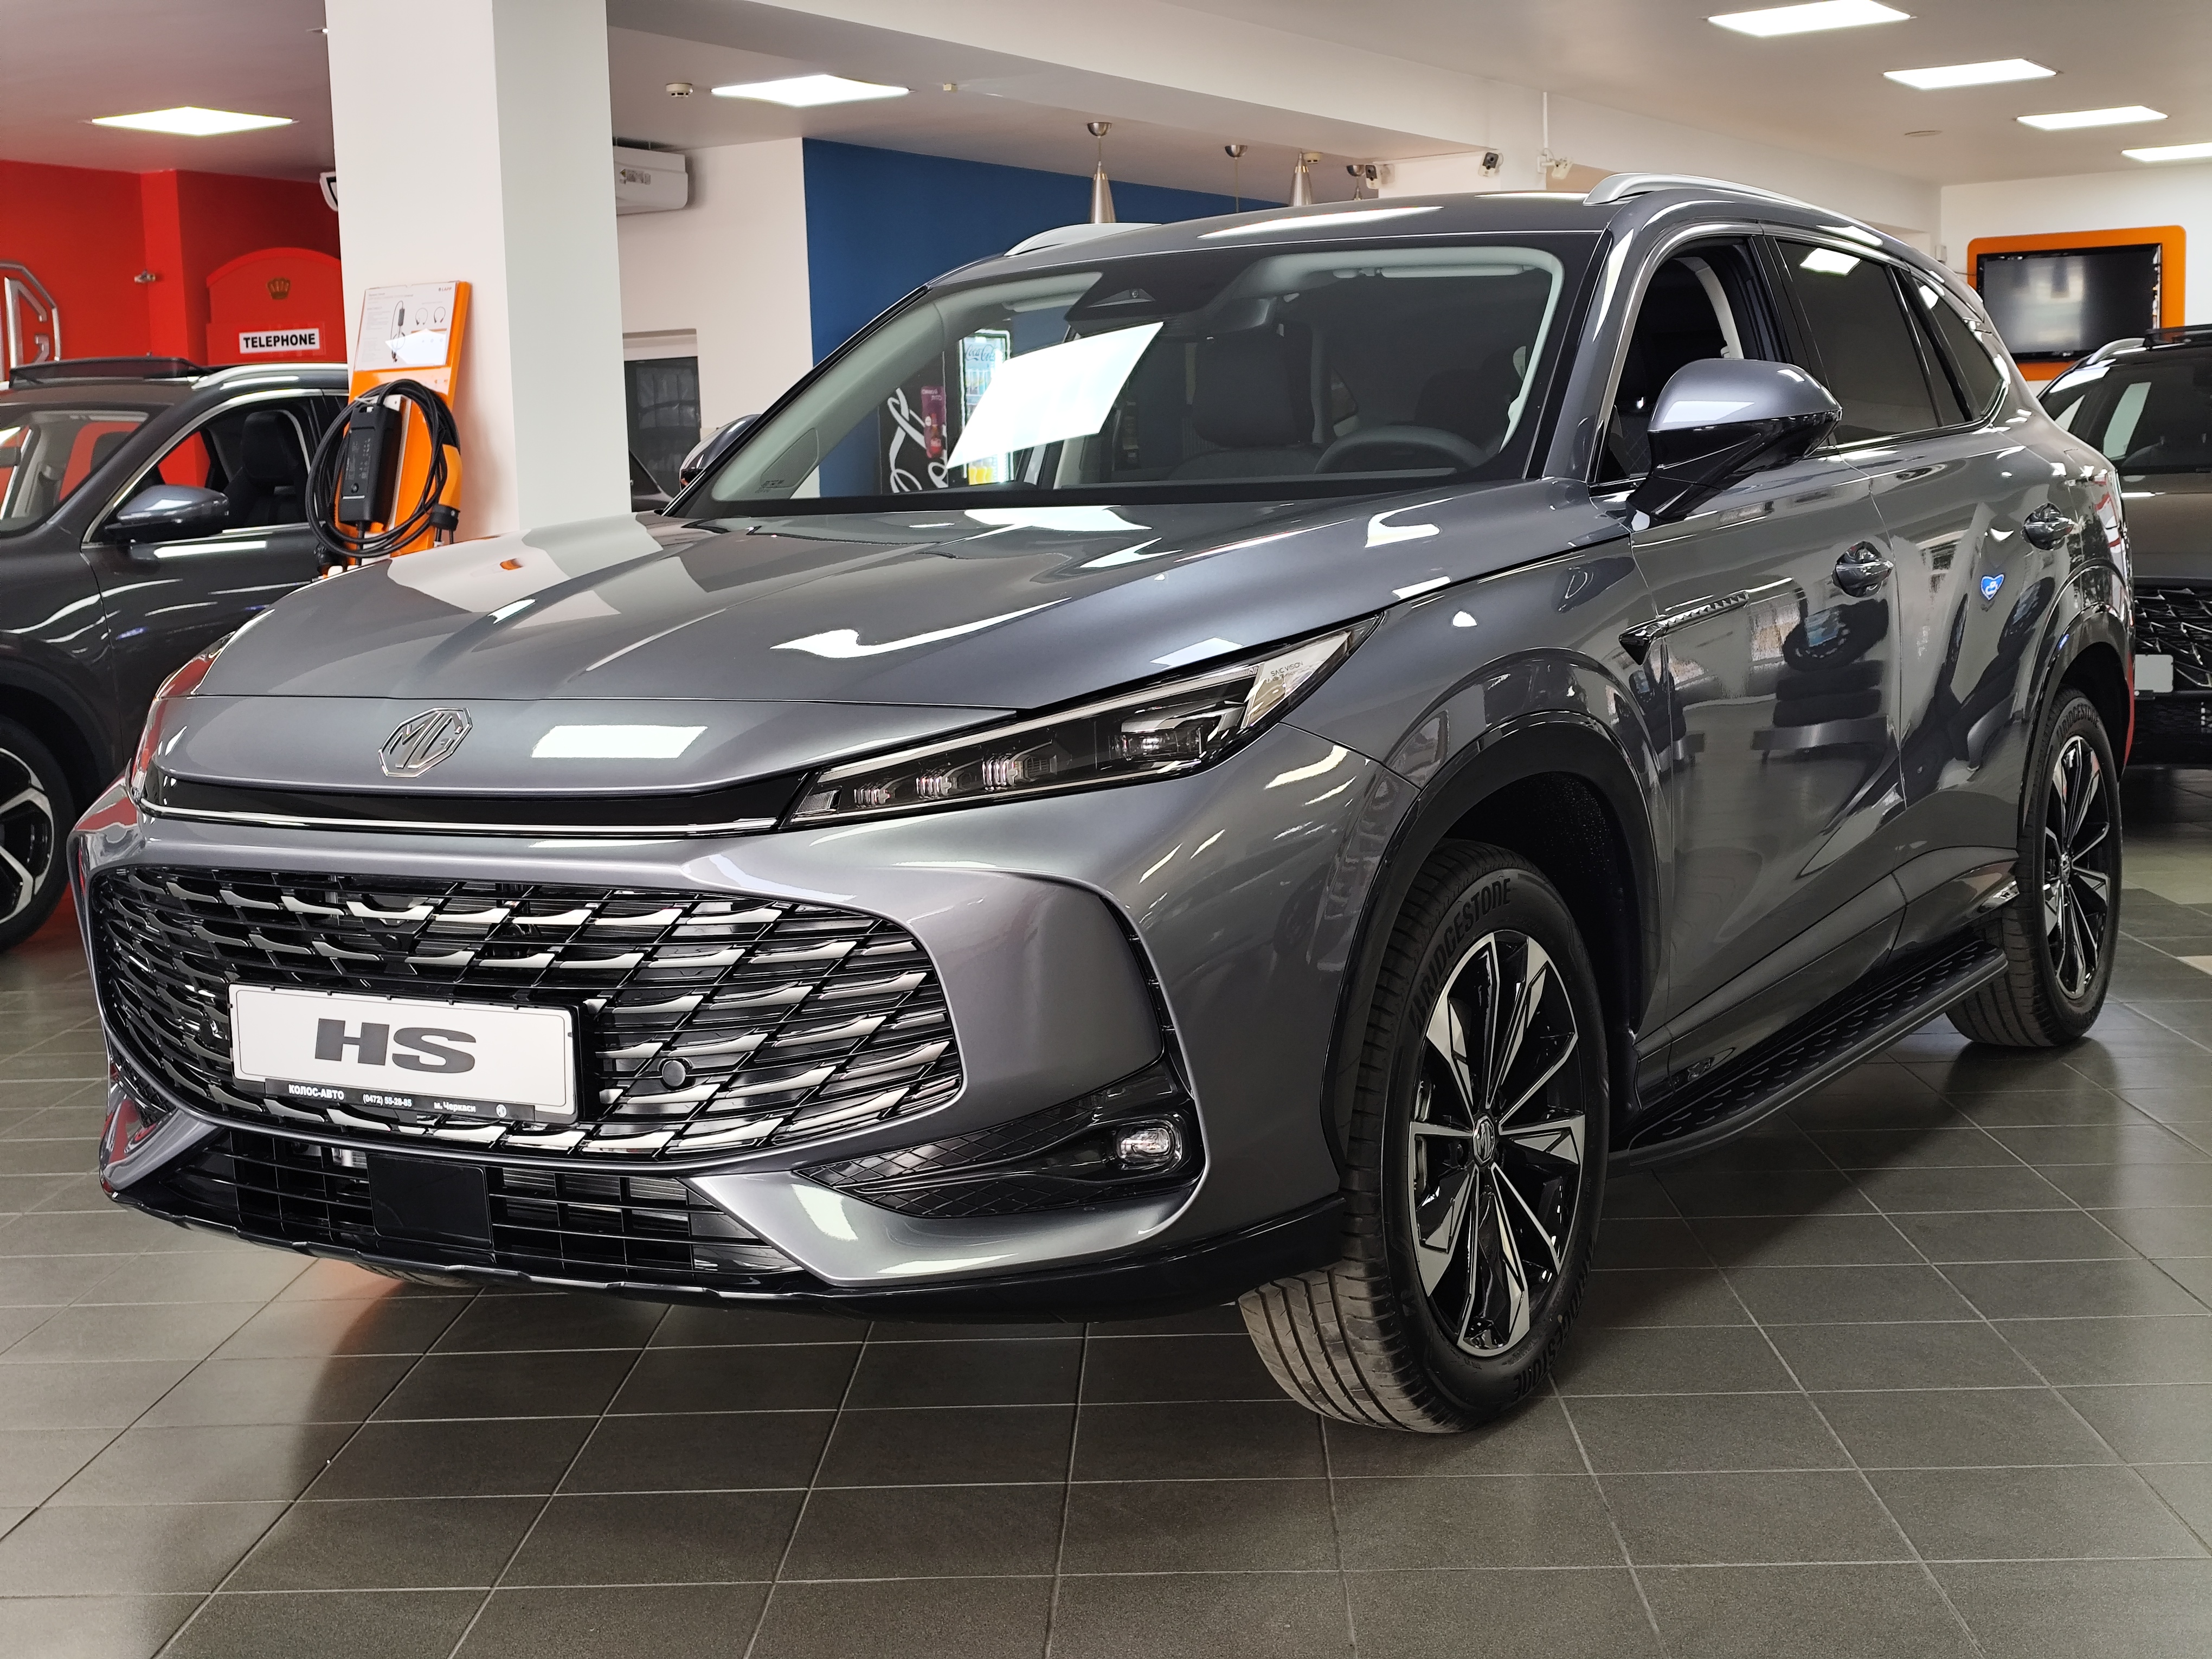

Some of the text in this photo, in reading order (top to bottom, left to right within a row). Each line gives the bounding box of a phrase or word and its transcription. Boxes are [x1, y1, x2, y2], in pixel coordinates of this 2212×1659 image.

[243, 333, 316, 349] TELEPHONE
[387, 711, 465, 770] MG
[1409, 878, 1512, 1038] BRIDGESTONE
[315, 1018, 476, 1073] HS
[288, 1084, 345, 1101] КОЛОС-АВТО
[363, 1094, 383, 1106] (0472)
